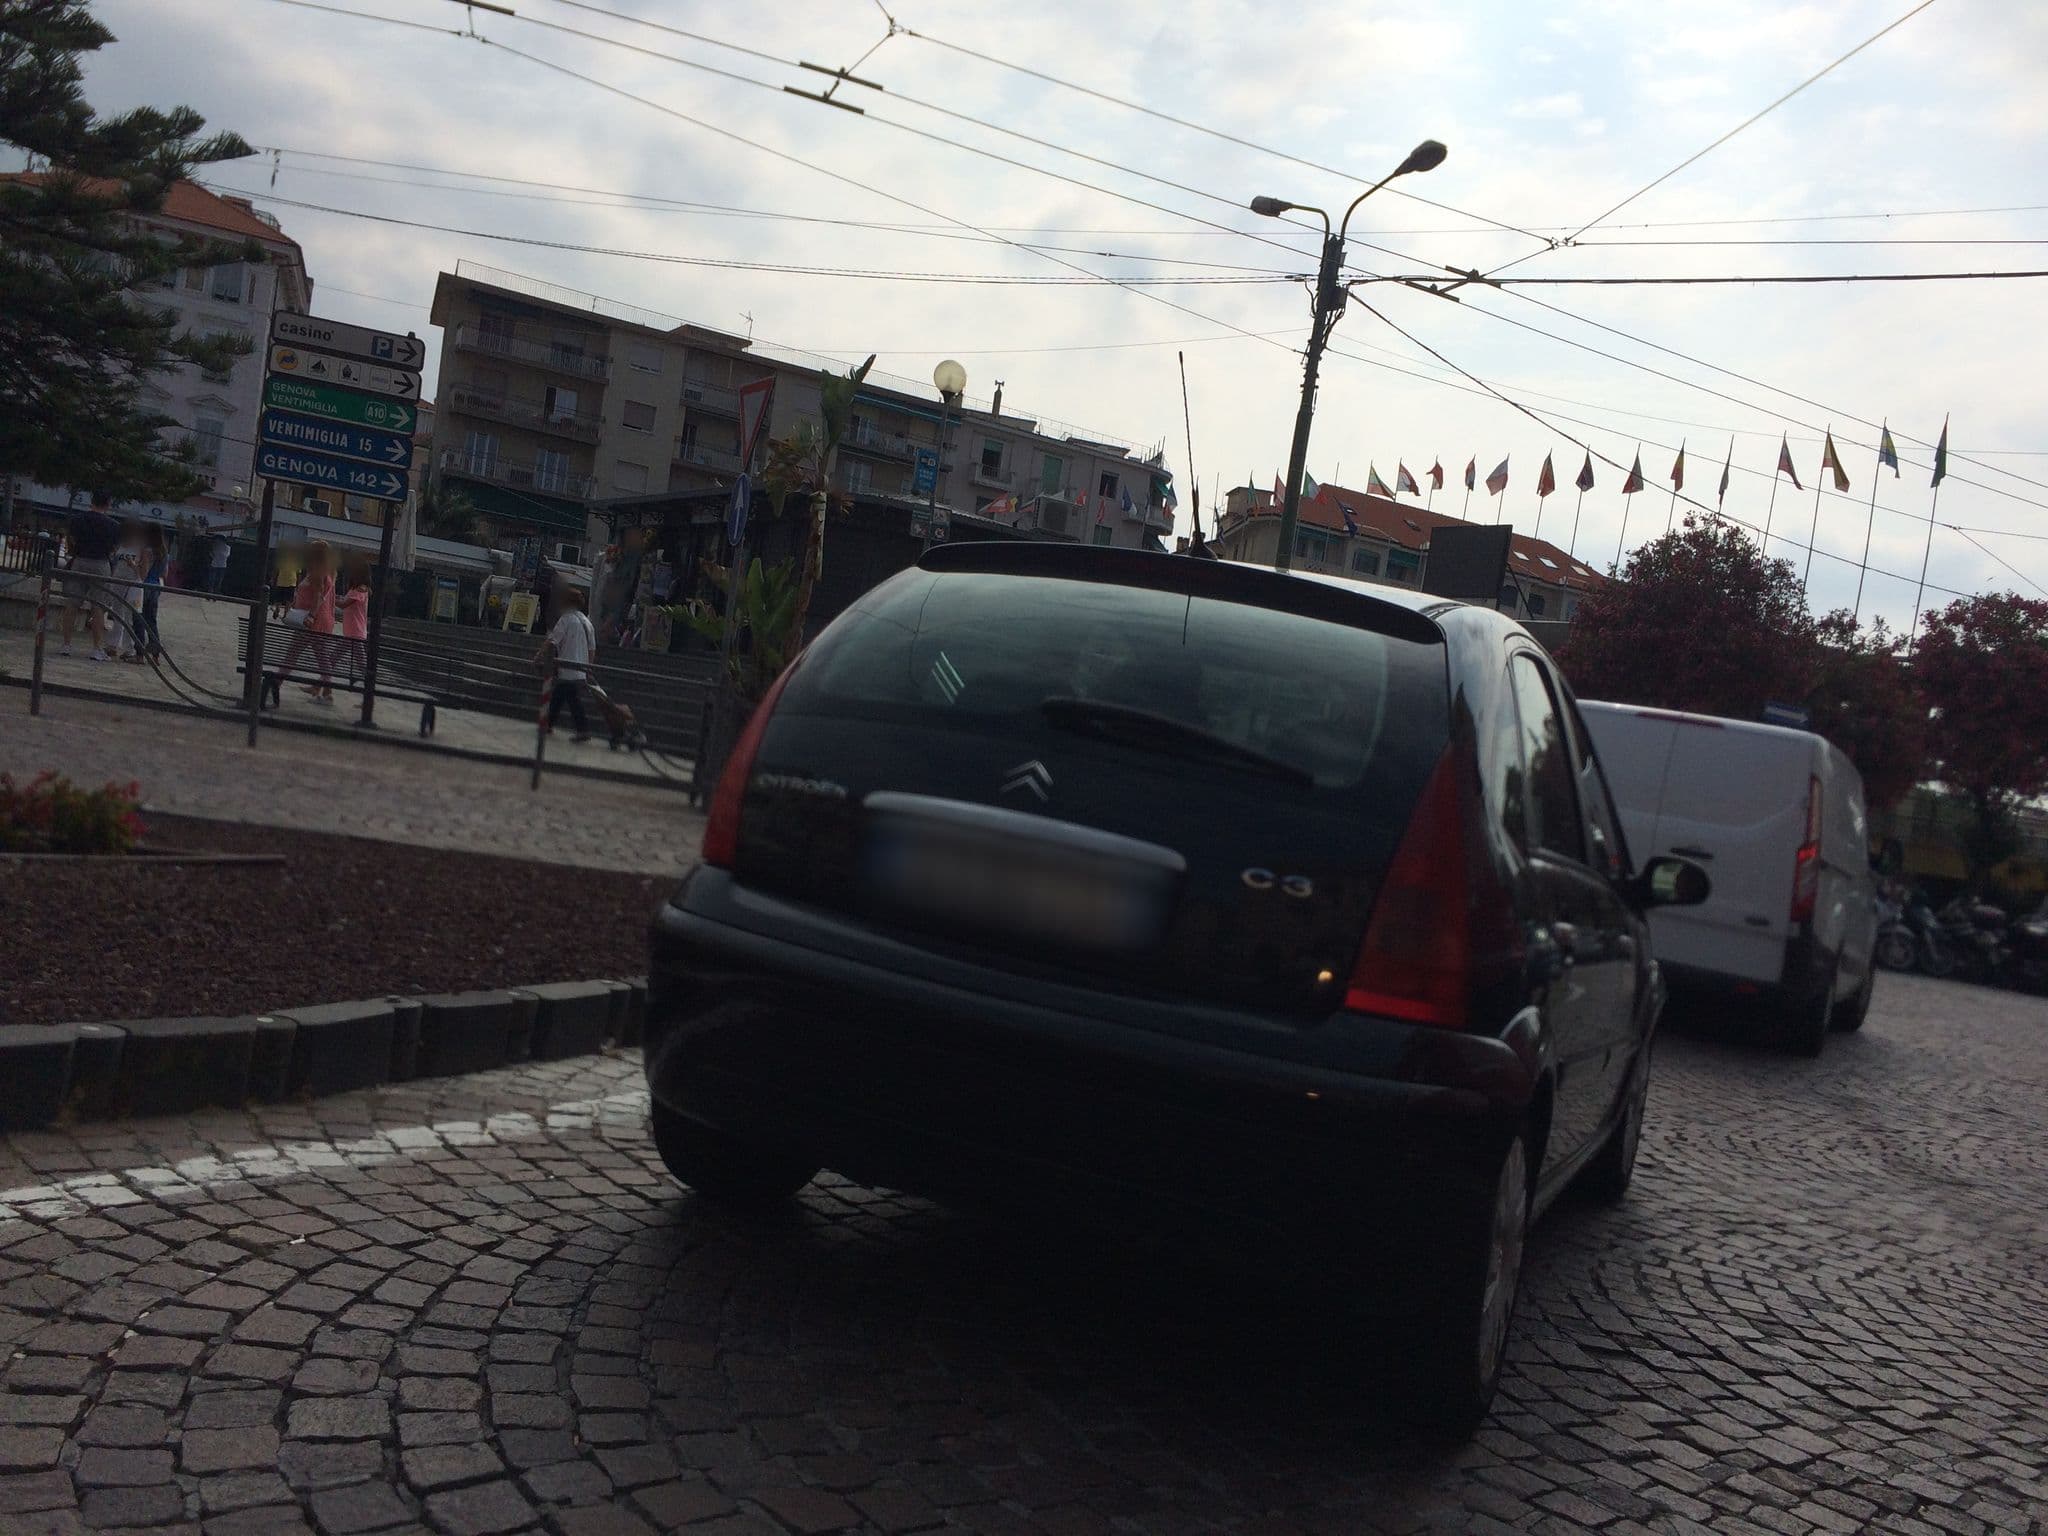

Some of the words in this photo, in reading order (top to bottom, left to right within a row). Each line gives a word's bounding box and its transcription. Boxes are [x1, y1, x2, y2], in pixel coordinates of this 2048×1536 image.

[271, 392, 338, 415] VENTIMIGLIA
[272, 382, 316, 398] GENOVA
[367, 409, 384, 420] A10
[268, 419, 349, 448] VENTIMIGLIA
[359, 437, 374, 453] 15
[263, 453, 339, 481] GENOVA
[349, 471, 378, 488] 142
[1240, 866, 1314, 899] C3
